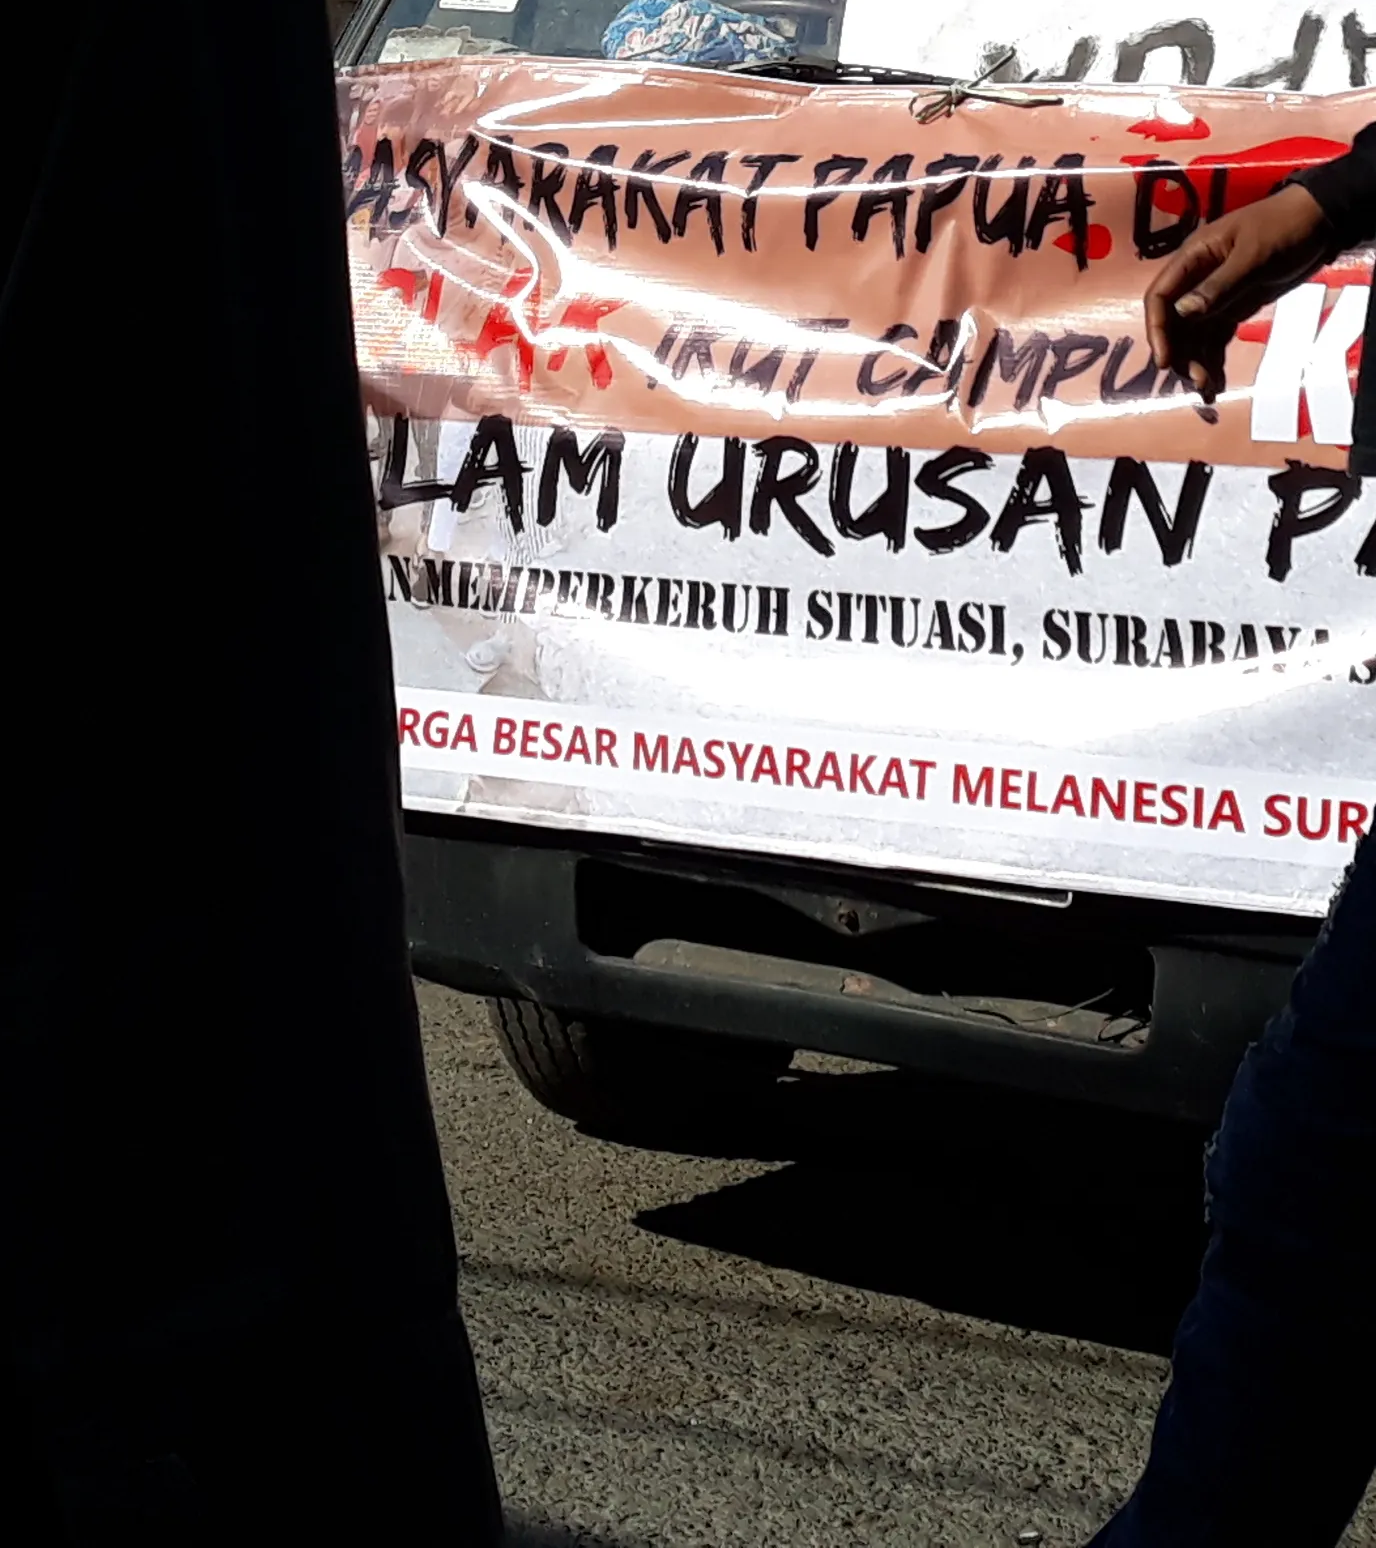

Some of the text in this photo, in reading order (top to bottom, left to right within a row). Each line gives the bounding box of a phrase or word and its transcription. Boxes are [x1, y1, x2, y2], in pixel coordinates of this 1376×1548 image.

[342, 133, 802, 257] ASYARAKAT
[803, 152, 1095, 272] PAPUA
[646, 318, 849, 403] IKUT
[369, 414, 625, 534] LAM
[667, 431, 1213, 577] URUSAN
[423, 558, 790, 638] MEMPERKERUH
[805, 590, 1024, 666] SITUASI,
[493, 717, 619, 768] BESAR
[632, 732, 936, 801] MASYARAKAT
[953, 763, 1245, 833] MELANESIA
